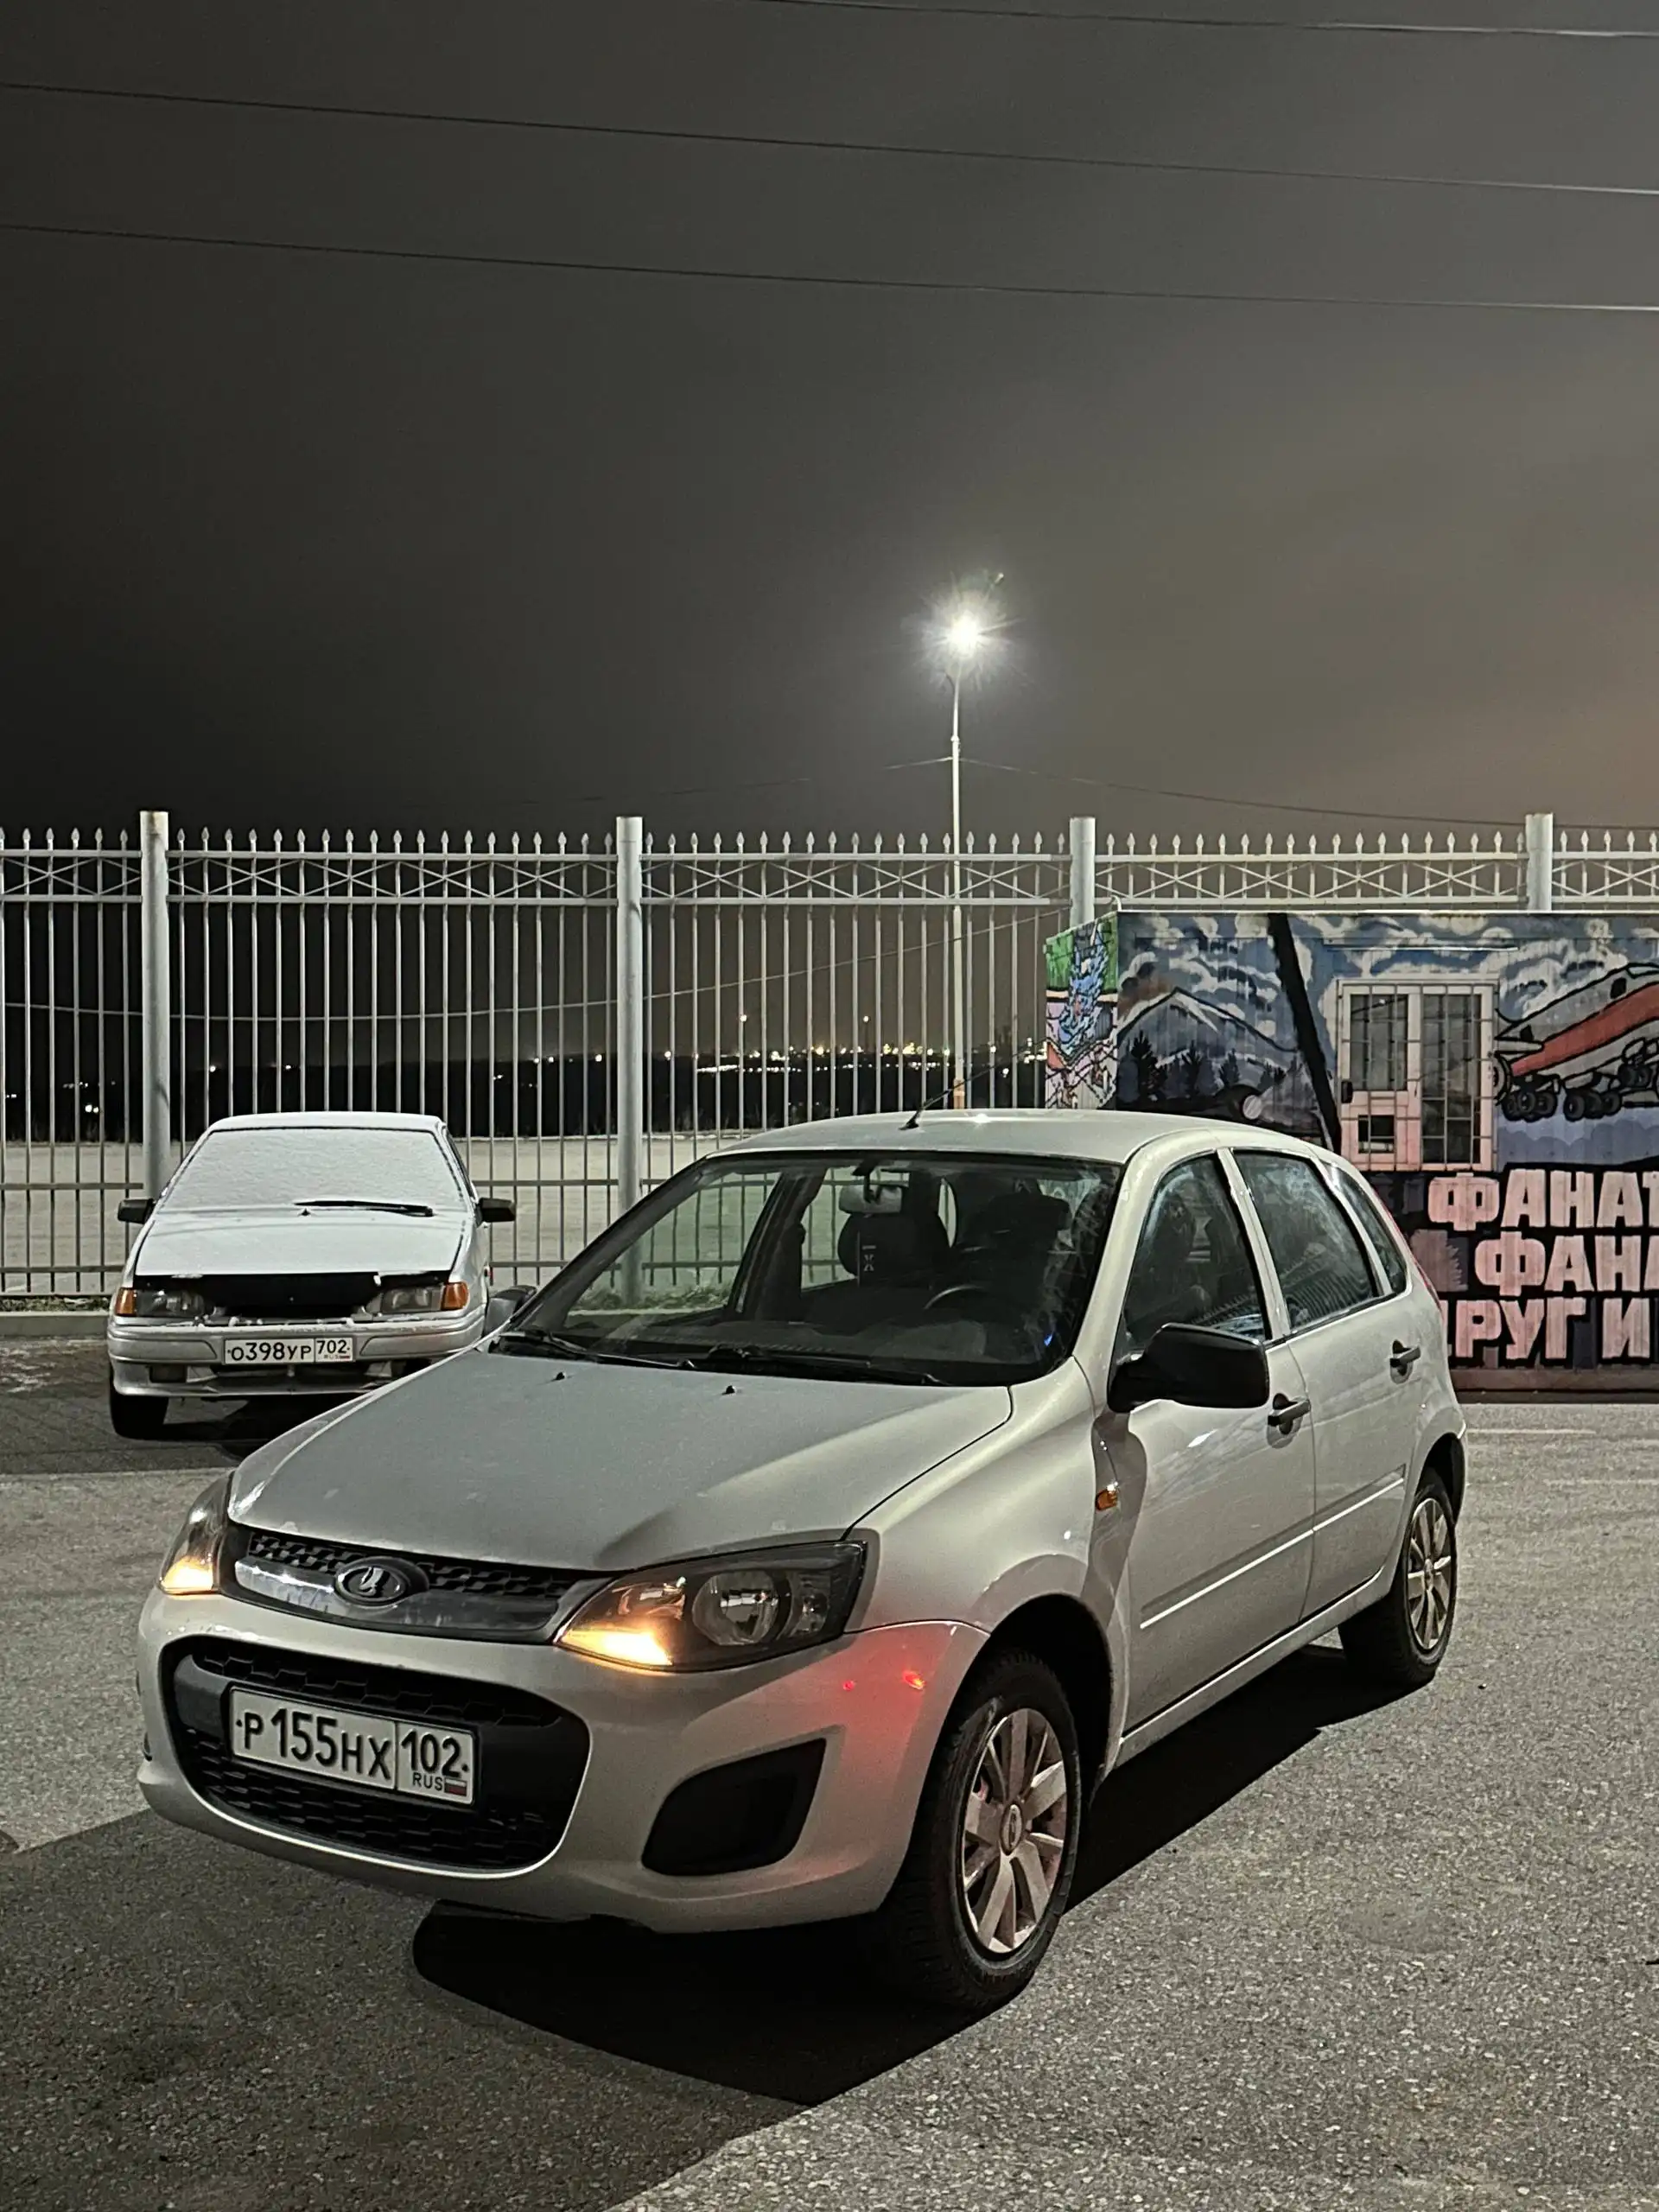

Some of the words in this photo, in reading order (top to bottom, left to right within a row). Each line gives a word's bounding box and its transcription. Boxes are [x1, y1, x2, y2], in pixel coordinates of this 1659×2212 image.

[1440, 1297, 1586, 1359] РУГ
[1601, 1298, 1650, 1359] И
[316, 1339, 347, 1354] 702
[401, 1729, 461, 1777] 102
[411, 1774, 443, 1791] RUS
